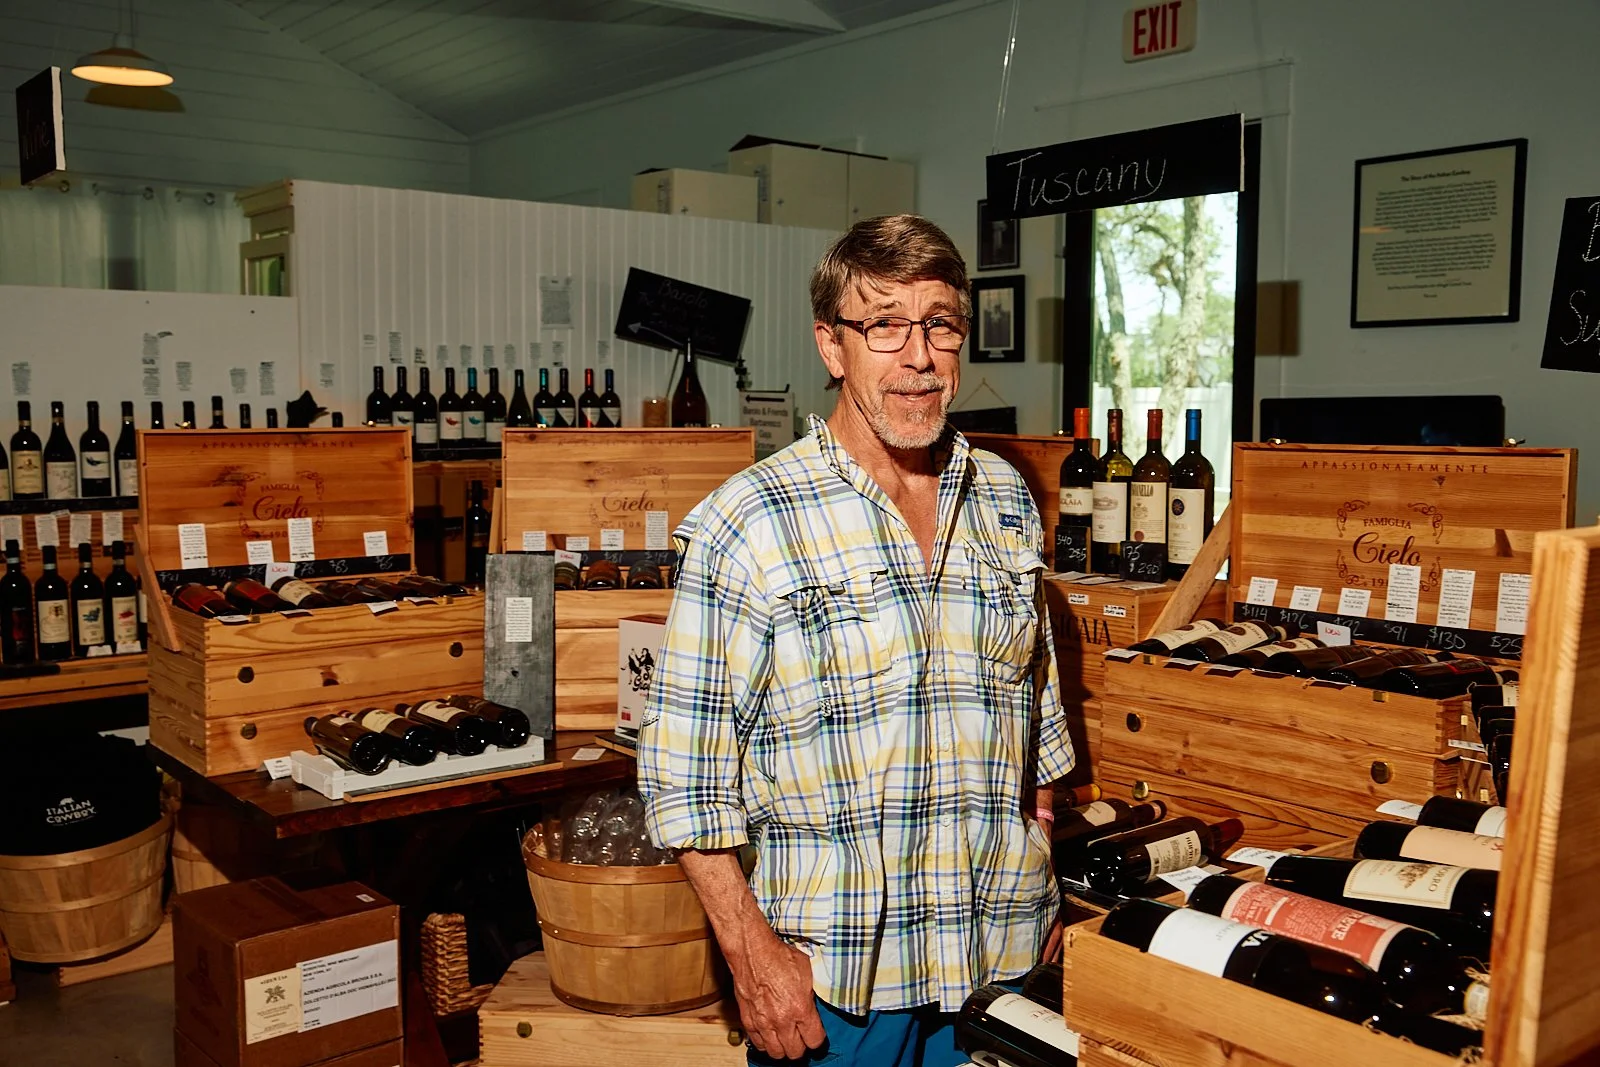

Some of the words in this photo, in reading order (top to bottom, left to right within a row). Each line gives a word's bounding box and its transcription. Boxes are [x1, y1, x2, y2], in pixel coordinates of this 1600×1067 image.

[1133, 2, 1182, 56] EXIT
[1006, 152, 1166, 211] Tuscany
[657, 279, 708, 309] Barolo
[1301, 460, 1490, 475] APPASSIONATAMENTE
[260, 483, 300, 493] FAMIGLIA
[253, 495, 309, 521] Cielo
[602, 490, 655, 513] Cielo
[1362, 516, 1412, 530] FAMIGLIA
[1352, 532, 1422, 567] Cielo
[1241, 605, 1268, 622] $114
[1279, 609, 1309, 630] $176
[1428, 627, 1466, 650] $130
[46, 800, 91, 815] ITALIAN
[46, 806, 97, 823] COWBOY
